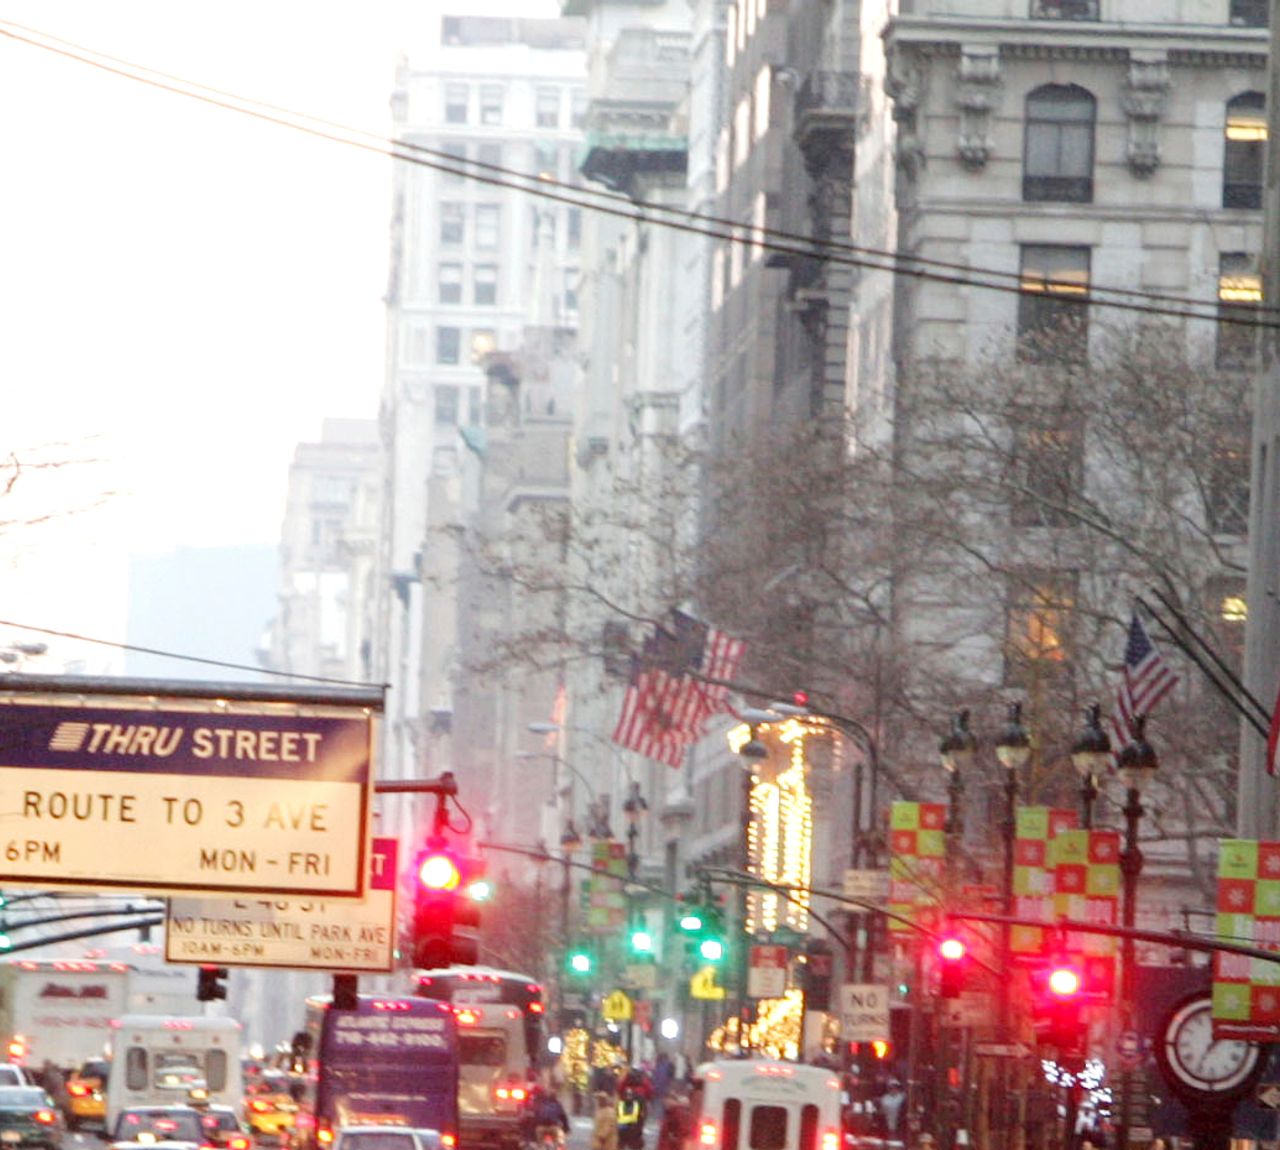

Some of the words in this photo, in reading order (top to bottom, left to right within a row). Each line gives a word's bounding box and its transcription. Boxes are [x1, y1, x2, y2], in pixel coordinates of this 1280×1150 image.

[87, 723, 184, 757] THRU
[192, 727, 322, 762] STREET
[23, 791, 137, 823] ROUTE
[163, 797, 203, 826] TO
[225, 800, 245, 828] 3
[264, 801, 328, 833] AVE
[5, 838, 62, 864] 6PM
[199, 848, 257, 874] MON
[288, 852, 331, 876] FRI
[173, 916, 195, 934] NO
[200, 917, 254, 939] TURNS
[260, 921, 304, 942] UNTIL
[311, 924, 353, 943] PARK
[359, 926, 386, 945] AVE
[851, 992, 878, 1010] NO
